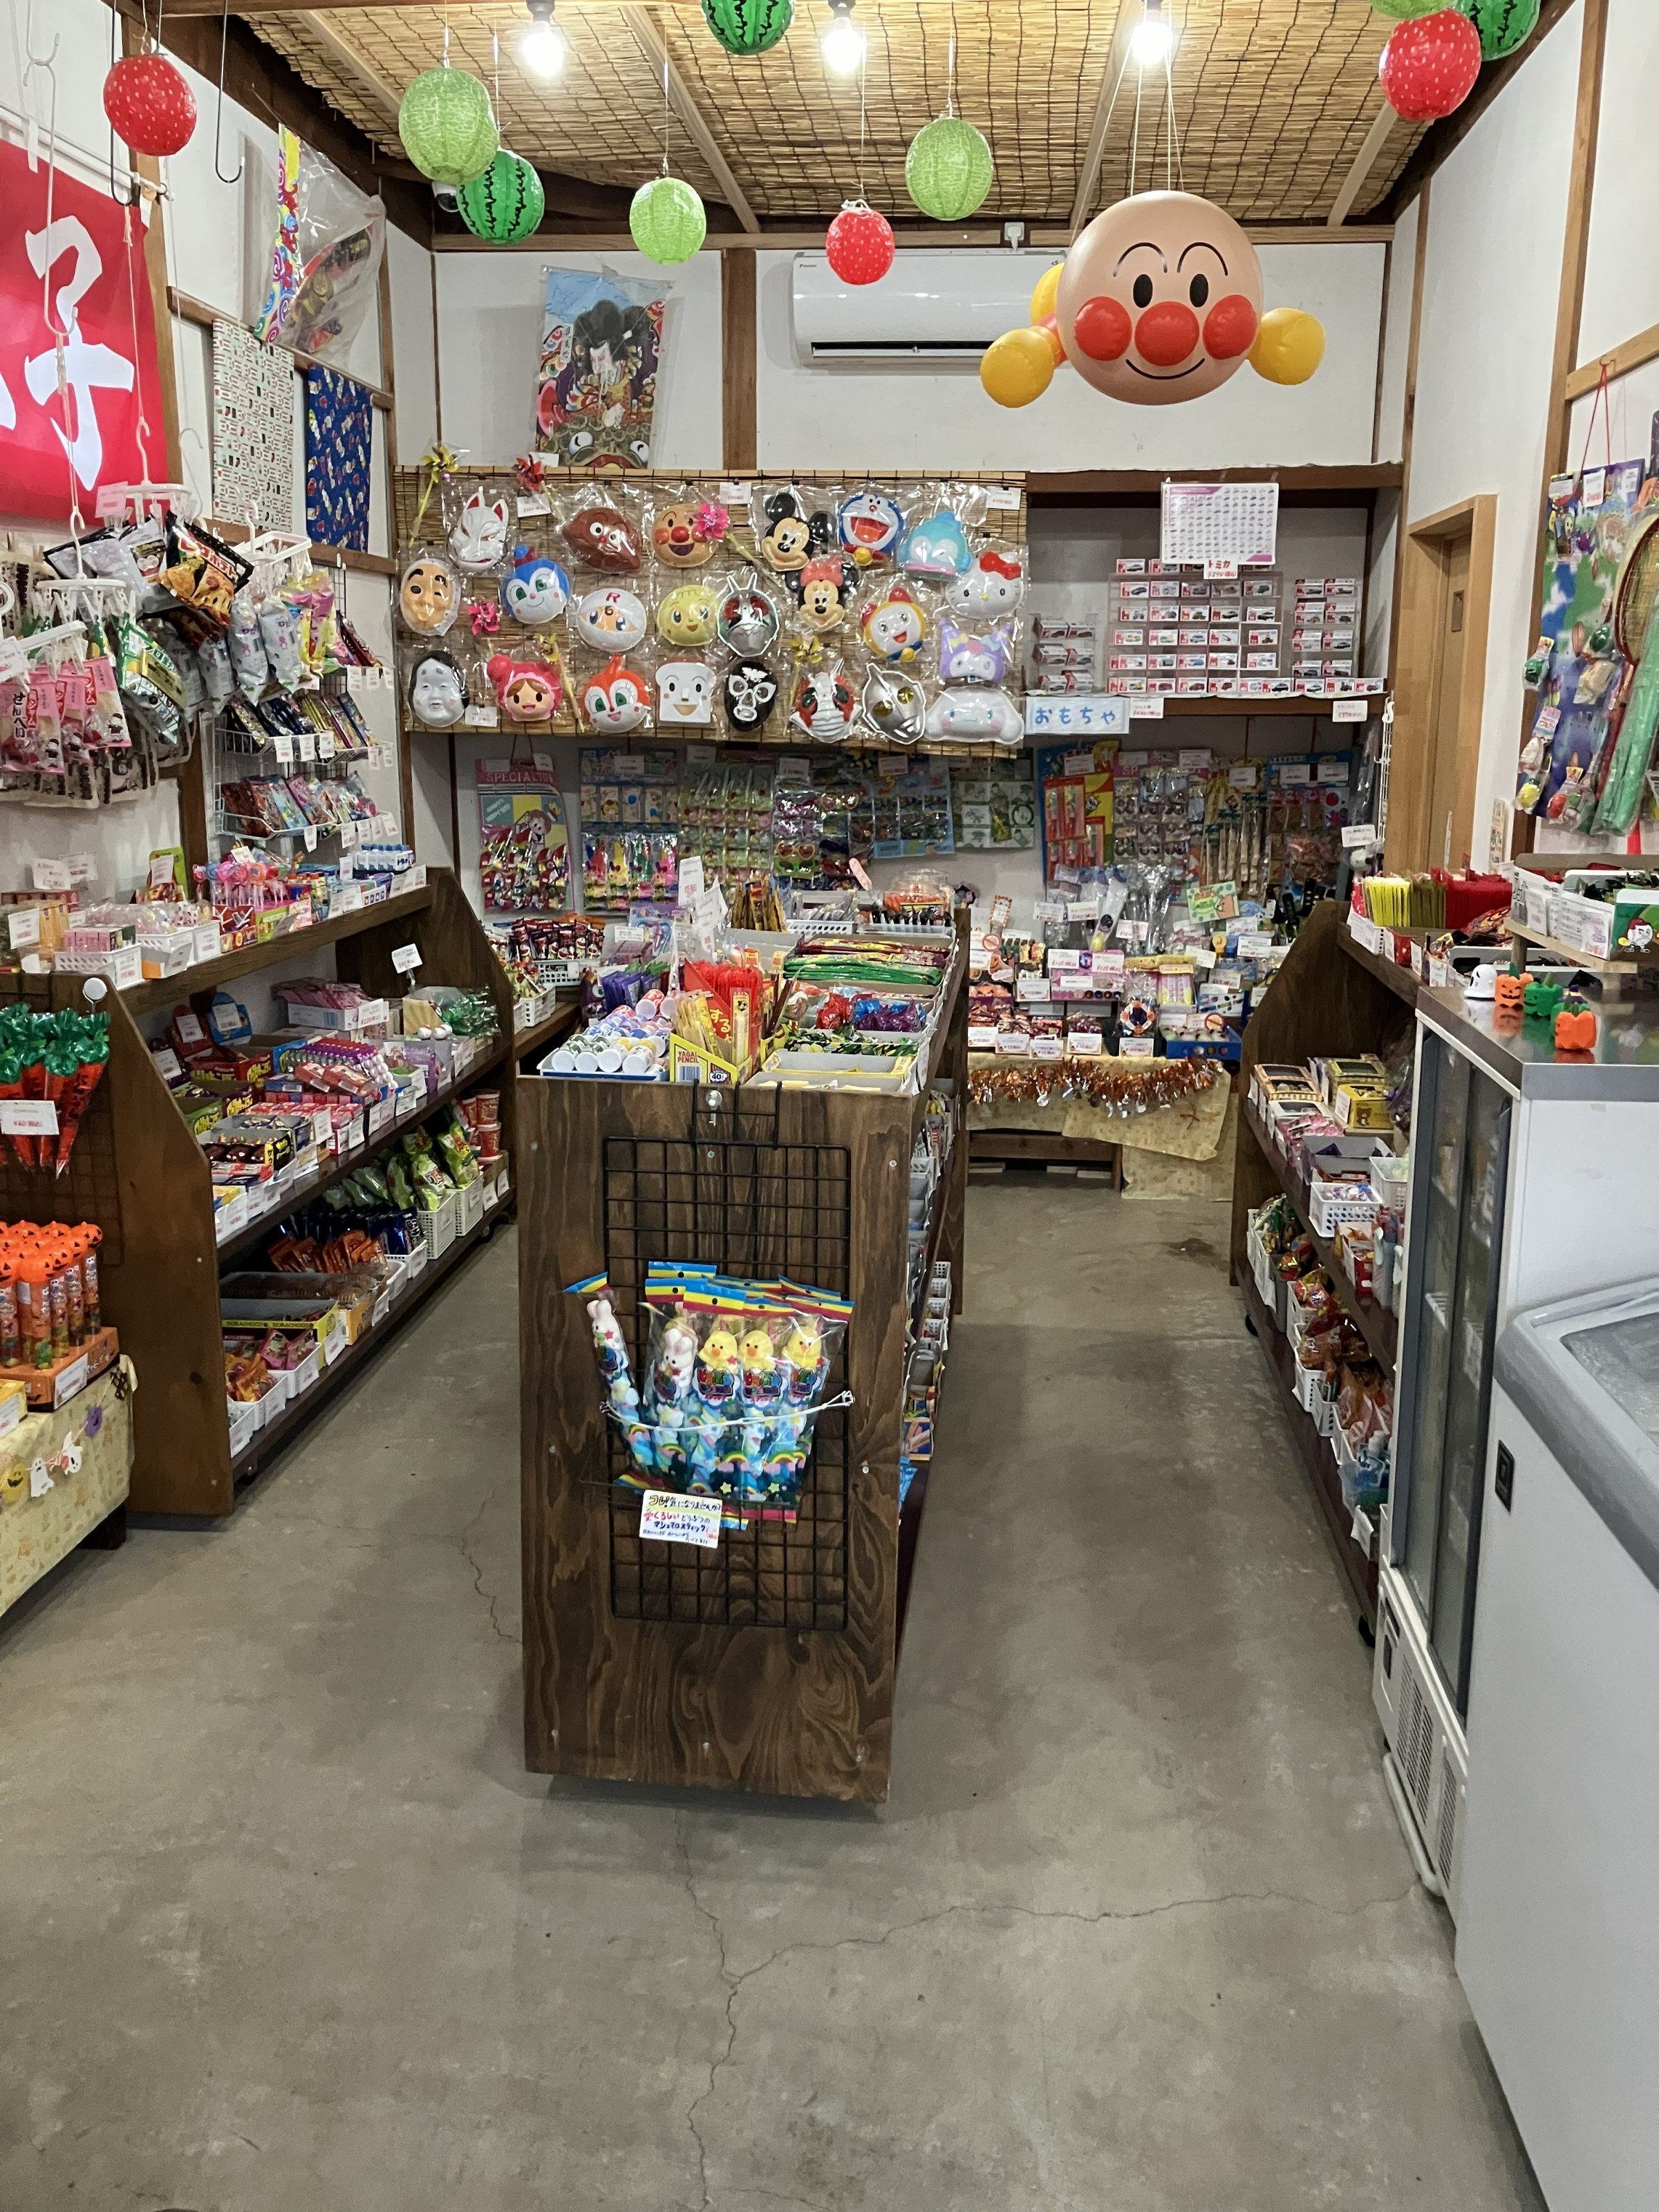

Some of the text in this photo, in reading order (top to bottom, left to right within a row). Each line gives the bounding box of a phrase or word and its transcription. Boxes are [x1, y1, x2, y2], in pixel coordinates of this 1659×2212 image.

[0, 215, 134, 491] 子
[1208, 560, 1230, 570] トミカ
[1035, 706, 1116, 725] おもちゃ
[654, 1521, 706, 1533] マシュマロスティック
